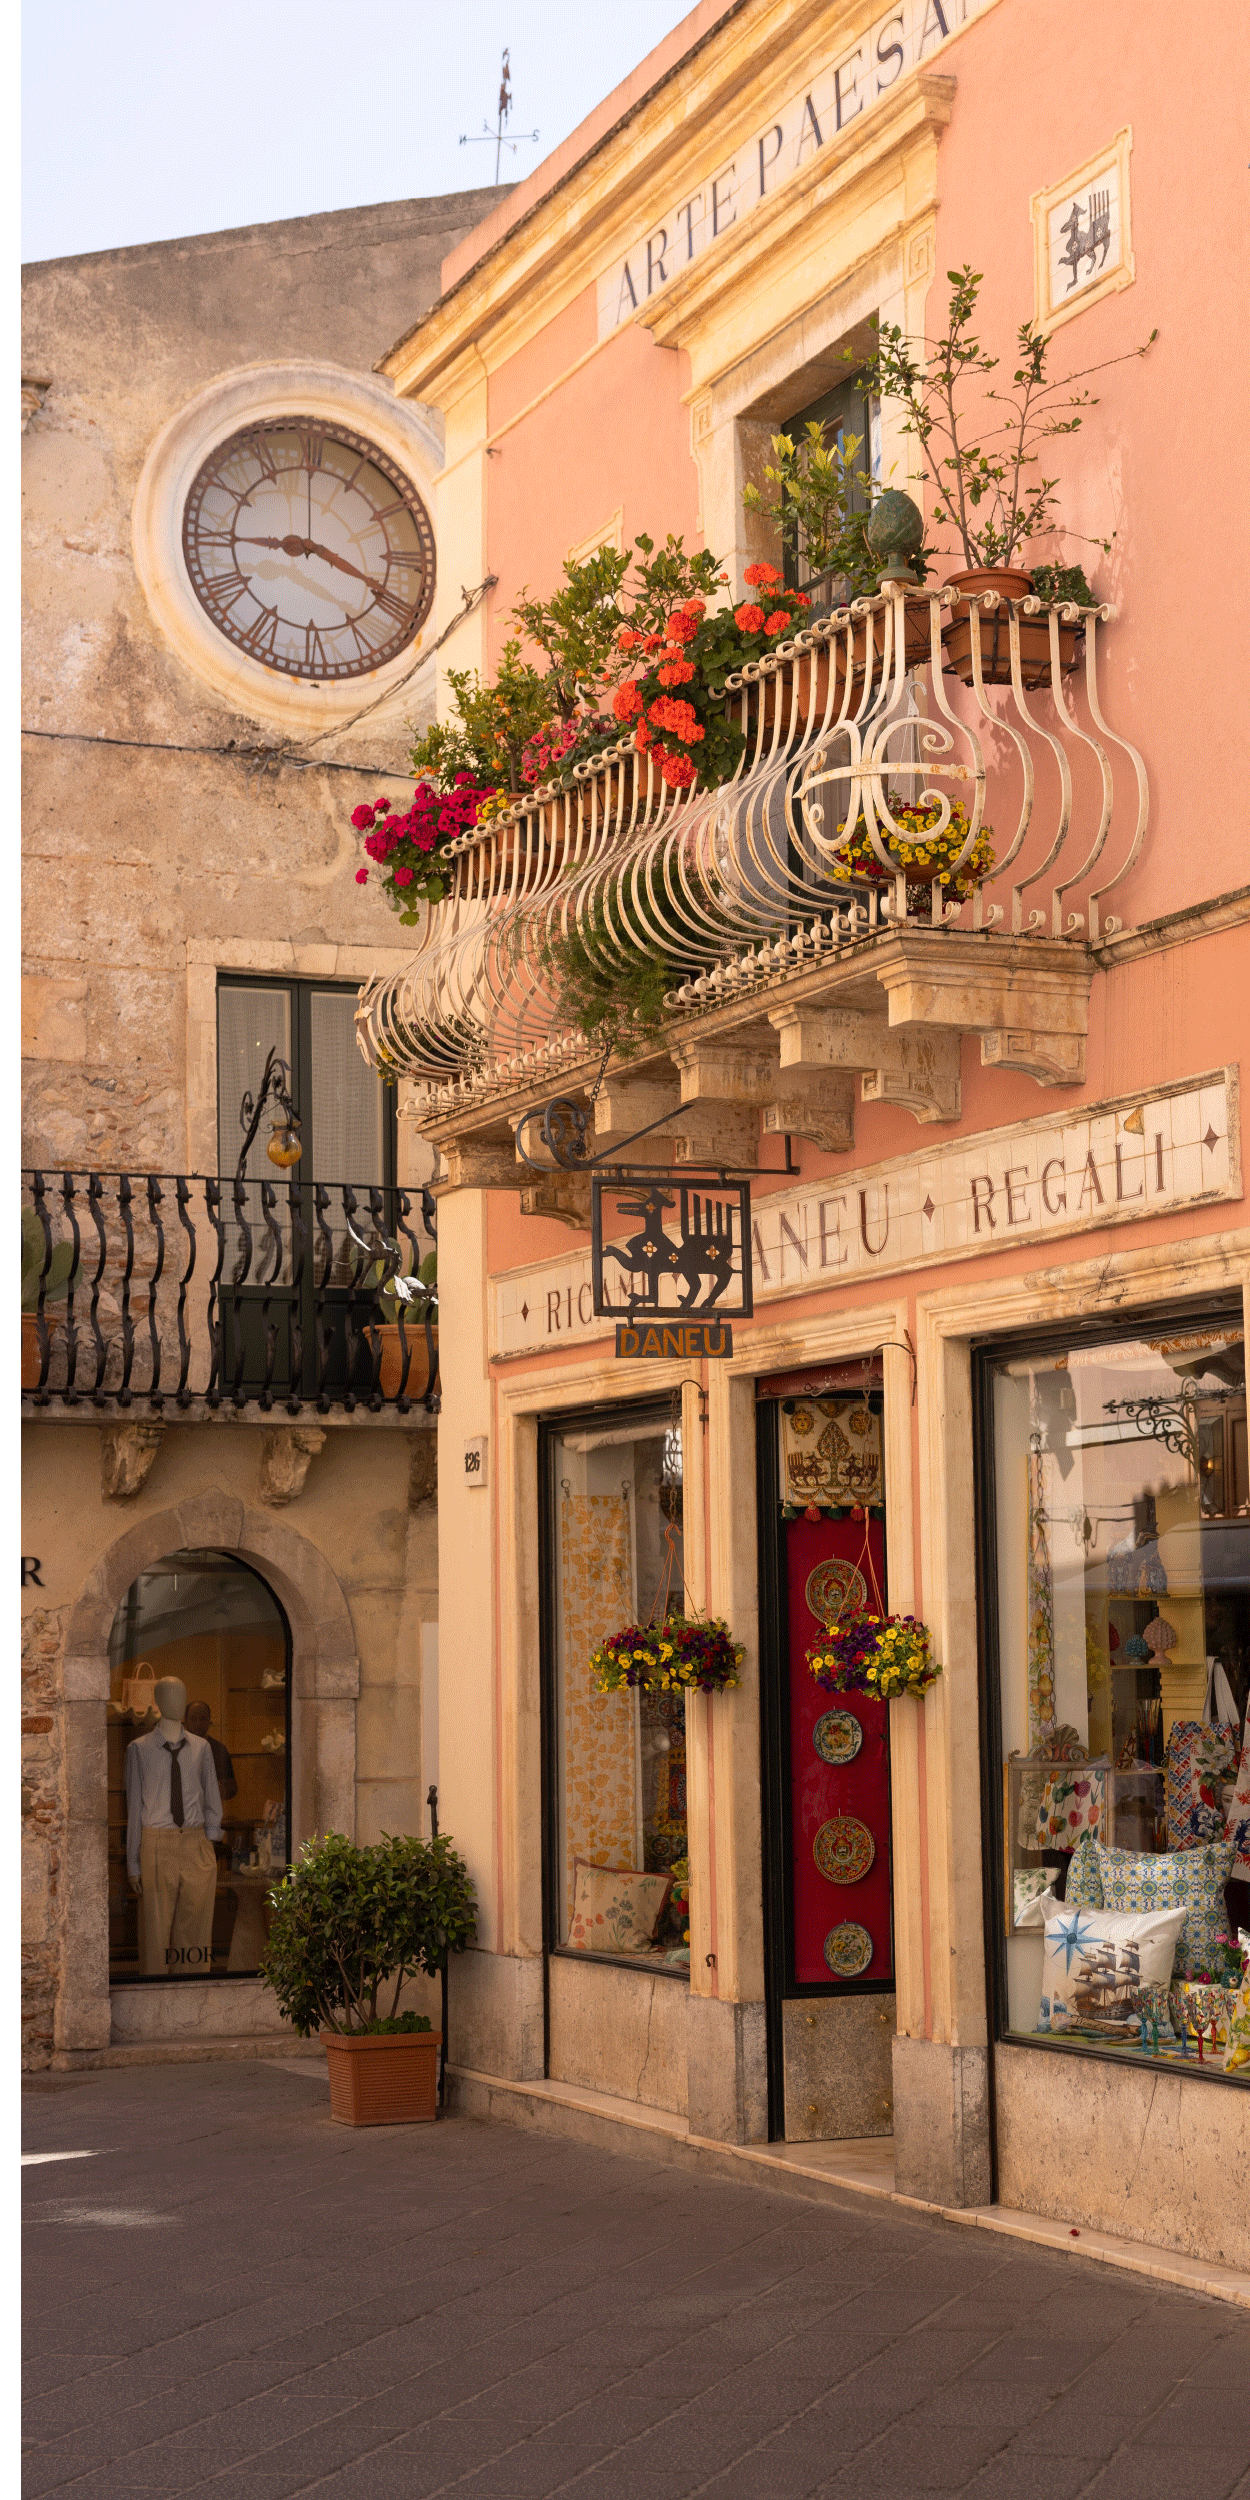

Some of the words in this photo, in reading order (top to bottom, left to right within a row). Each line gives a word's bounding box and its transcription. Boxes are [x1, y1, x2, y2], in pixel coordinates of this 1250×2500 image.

[615, 163, 738, 325] ARTE
[757, 0, 967, 198] PAESA
[708, 1183, 890, 1296] ANEU
[970, 1131, 1166, 1234] REGALI
[619, 1327, 727, 1357] DANEU
[464, 1450, 480, 1473] 126
[164, 1946, 217, 1966] DIOR
